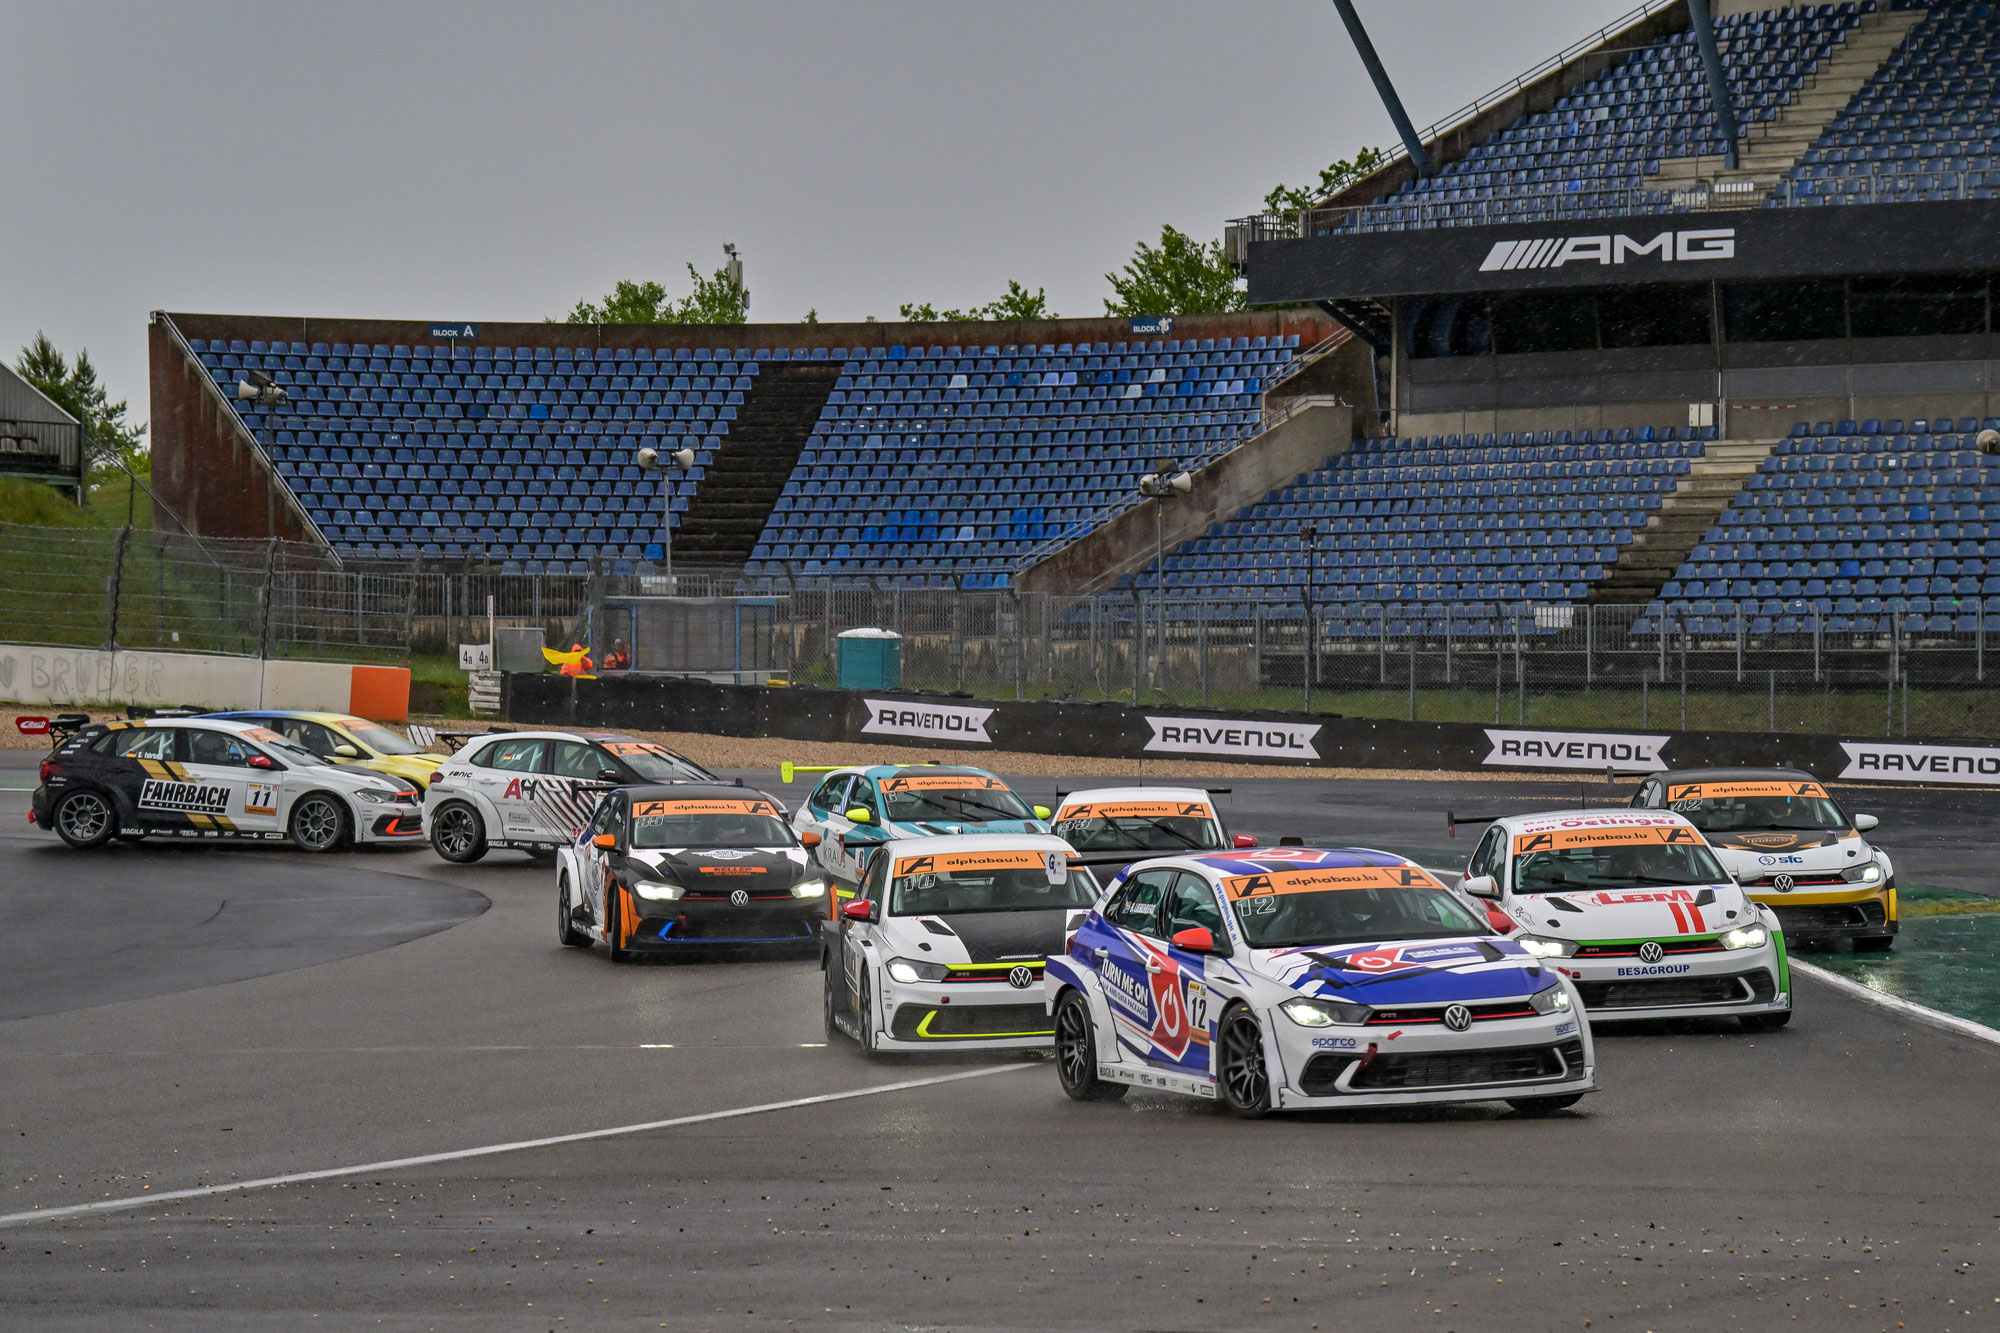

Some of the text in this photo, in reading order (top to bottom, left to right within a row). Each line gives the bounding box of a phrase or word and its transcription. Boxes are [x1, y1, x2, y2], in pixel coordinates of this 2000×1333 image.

[1550, 228, 1735, 268] AMG
[432, 324, 475, 337] BLOCK A
[1132, 325, 1156, 333] BLOCK
[463, 650, 473, 665] 4a
[479, 650, 489, 664] 4a
[32, 654, 165, 697] BRUDER
[878, 708, 978, 733] RAVENOL
[1161, 726, 1304, 750] RAVENOL
[1501, 739, 1652, 762] RAVENOL
[143, 781, 232, 807] FAHRBACH
[252, 790, 271, 807] 11
[150, 802, 217, 812] MOTORSPORT
[1672, 798, 1704, 812] 42
[1525, 818, 1677, 833] von Oetinger
[1565, 833, 1648, 843] alphabau.lu
[859, 850, 864, 869] 6
[946, 856, 1028, 866] alphabau.lu
[1778, 855, 1804, 864] sfc
[1286, 873, 1379, 887] alphabau.lu
[1597, 889, 1694, 905] LBM
[1236, 896, 1277, 918] 12
[1617, 965, 1691, 977] BESAGROUP
[1101, 958, 1149, 1007] TURN ME ON
[1192, 997, 1207, 1029] 12
[1312, 1037, 1356, 1049] sparco
